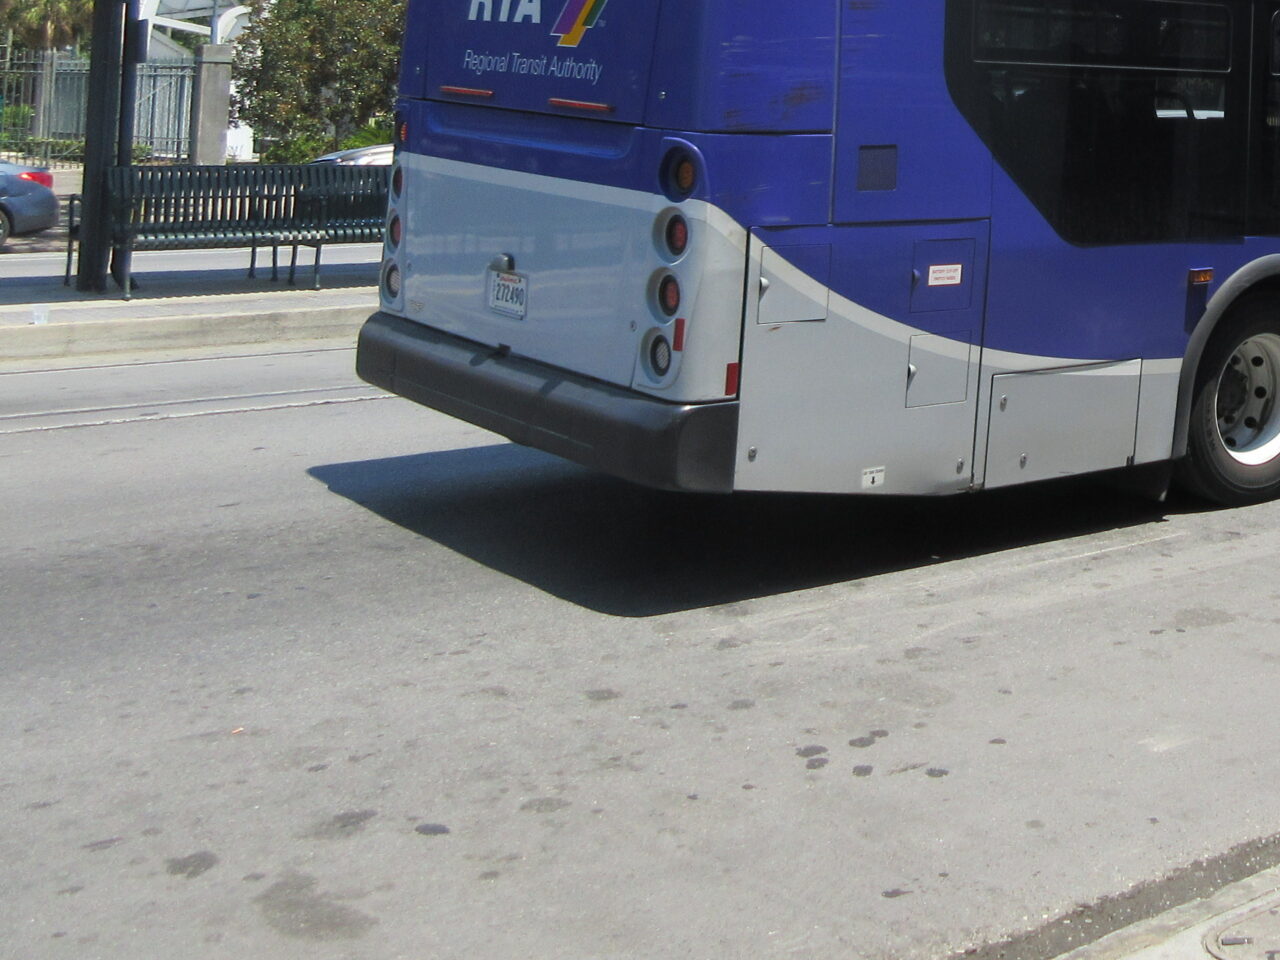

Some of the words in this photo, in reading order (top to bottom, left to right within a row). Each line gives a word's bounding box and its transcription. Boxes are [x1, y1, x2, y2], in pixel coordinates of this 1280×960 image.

[463, 49, 509, 75] Regional
[512, 52, 548, 75] Transit
[549, 55, 603, 86] Authority
